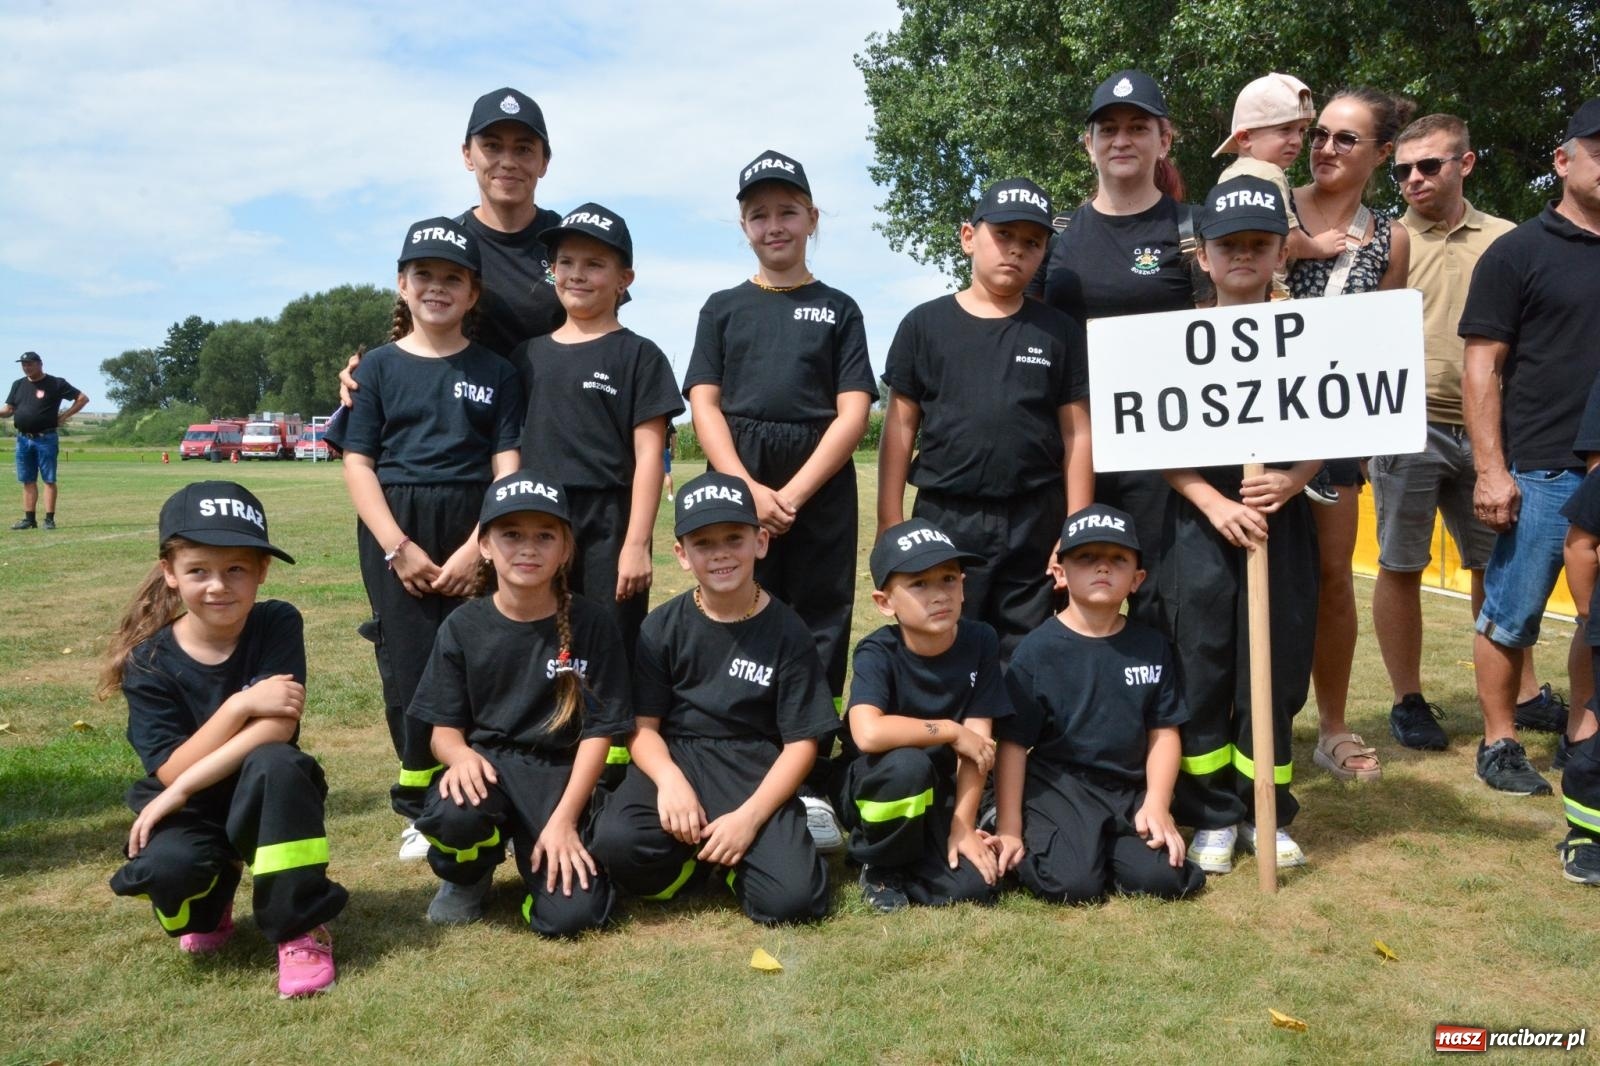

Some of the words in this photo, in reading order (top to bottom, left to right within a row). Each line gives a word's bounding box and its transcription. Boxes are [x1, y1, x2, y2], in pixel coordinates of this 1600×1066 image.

[1028, 346, 1043, 355] OSP
[1186, 312, 1306, 366] OSP
[1113, 360, 1410, 435] ROSZKÓW
